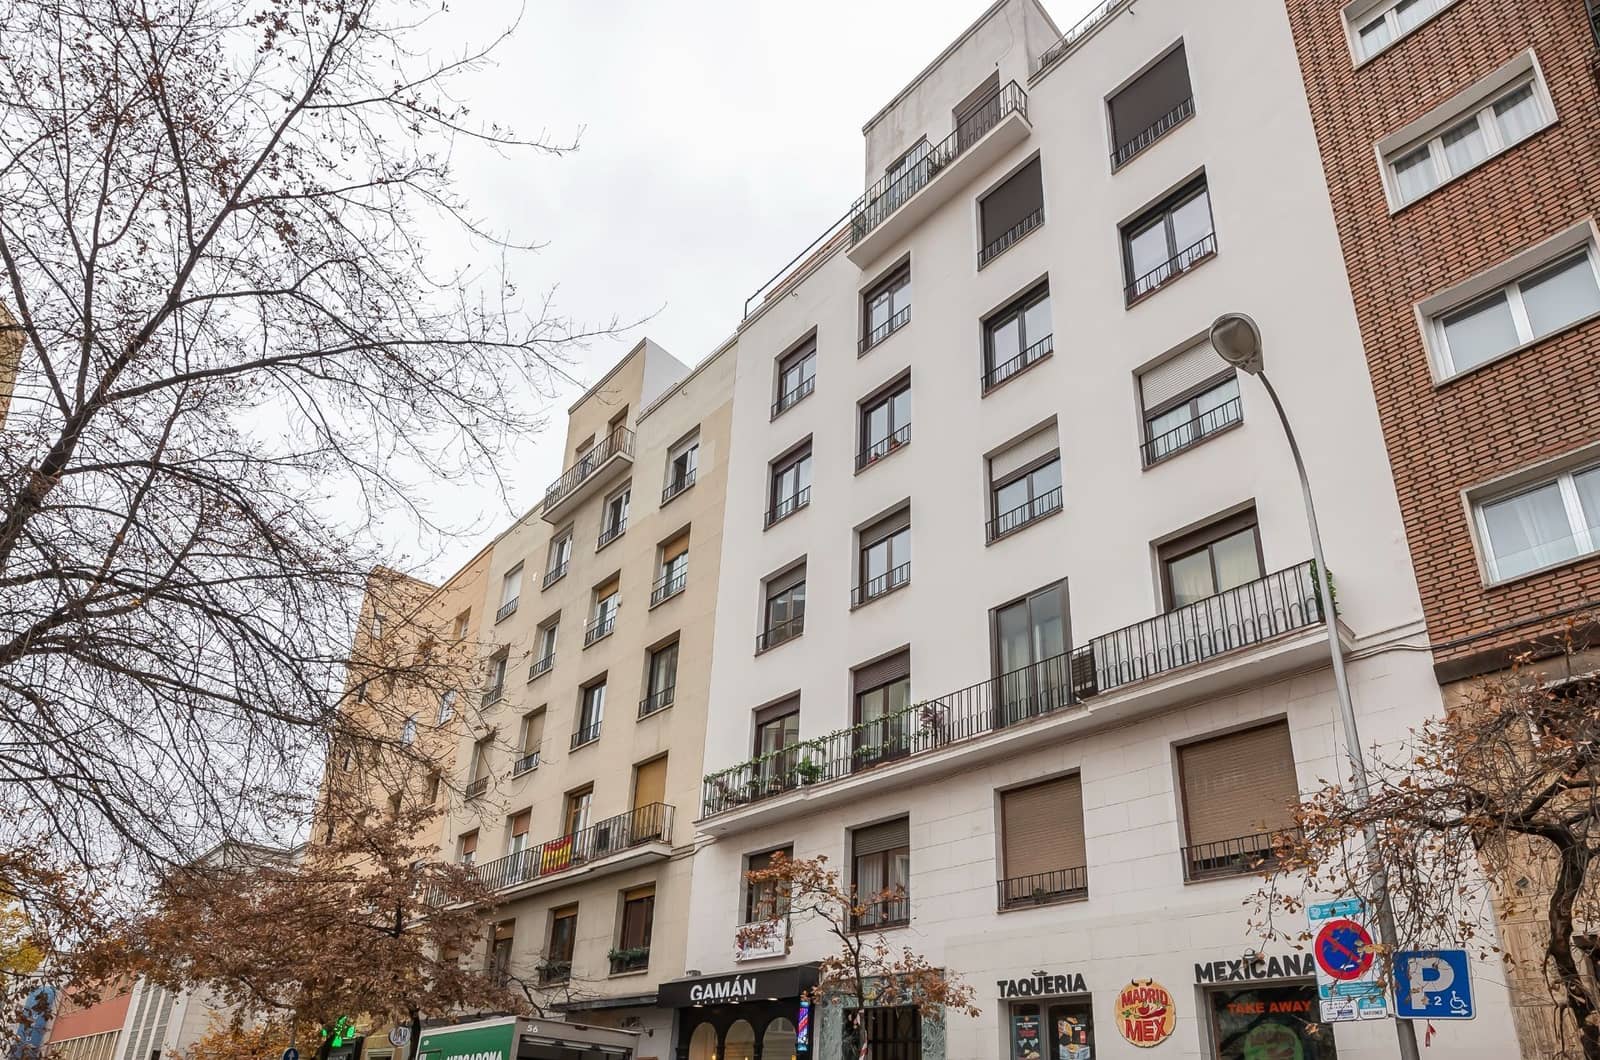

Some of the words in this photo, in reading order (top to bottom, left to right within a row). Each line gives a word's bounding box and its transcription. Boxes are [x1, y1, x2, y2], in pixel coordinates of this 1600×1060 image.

[1194, 953, 1317, 983] MEXICANA
[690, 975, 757, 1001] GAMÁN
[997, 973, 1088, 998] TAQUERIA
[1121, 987, 1169, 1008] MADRID
[1227, 1003, 1265, 1015] TAKE
[1269, 1001, 1312, 1014] AWAY
[1433, 996, 1443, 1006] 2
[526, 1024, 539, 1033] 56
[1125, 1018, 1167, 1042] MEX
